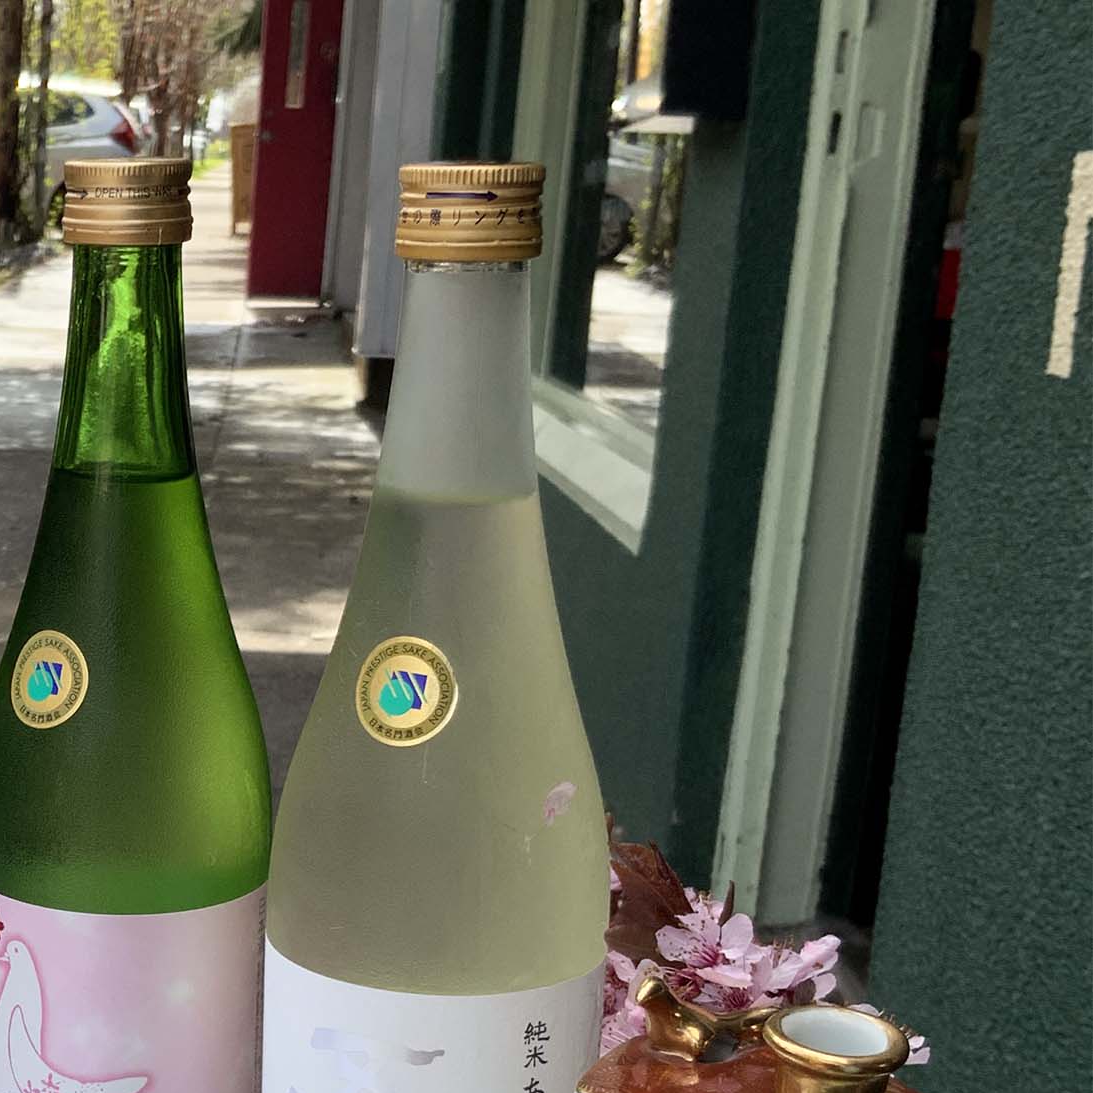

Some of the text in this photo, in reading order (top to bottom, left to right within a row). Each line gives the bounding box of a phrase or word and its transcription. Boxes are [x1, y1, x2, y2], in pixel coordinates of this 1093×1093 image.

[94, 187, 123, 199] OPEN
[127, 187, 151, 199] THIS
[44, 638, 62, 649] SAKE
[63, 649, 83, 709] ASSOCIATION
[366, 645, 399, 678] PRESTIGE
[401, 644, 428, 659] SAKE
[427, 656, 451, 725] ASSOCIATION
[523, 1020, 551, 1068] 純米
